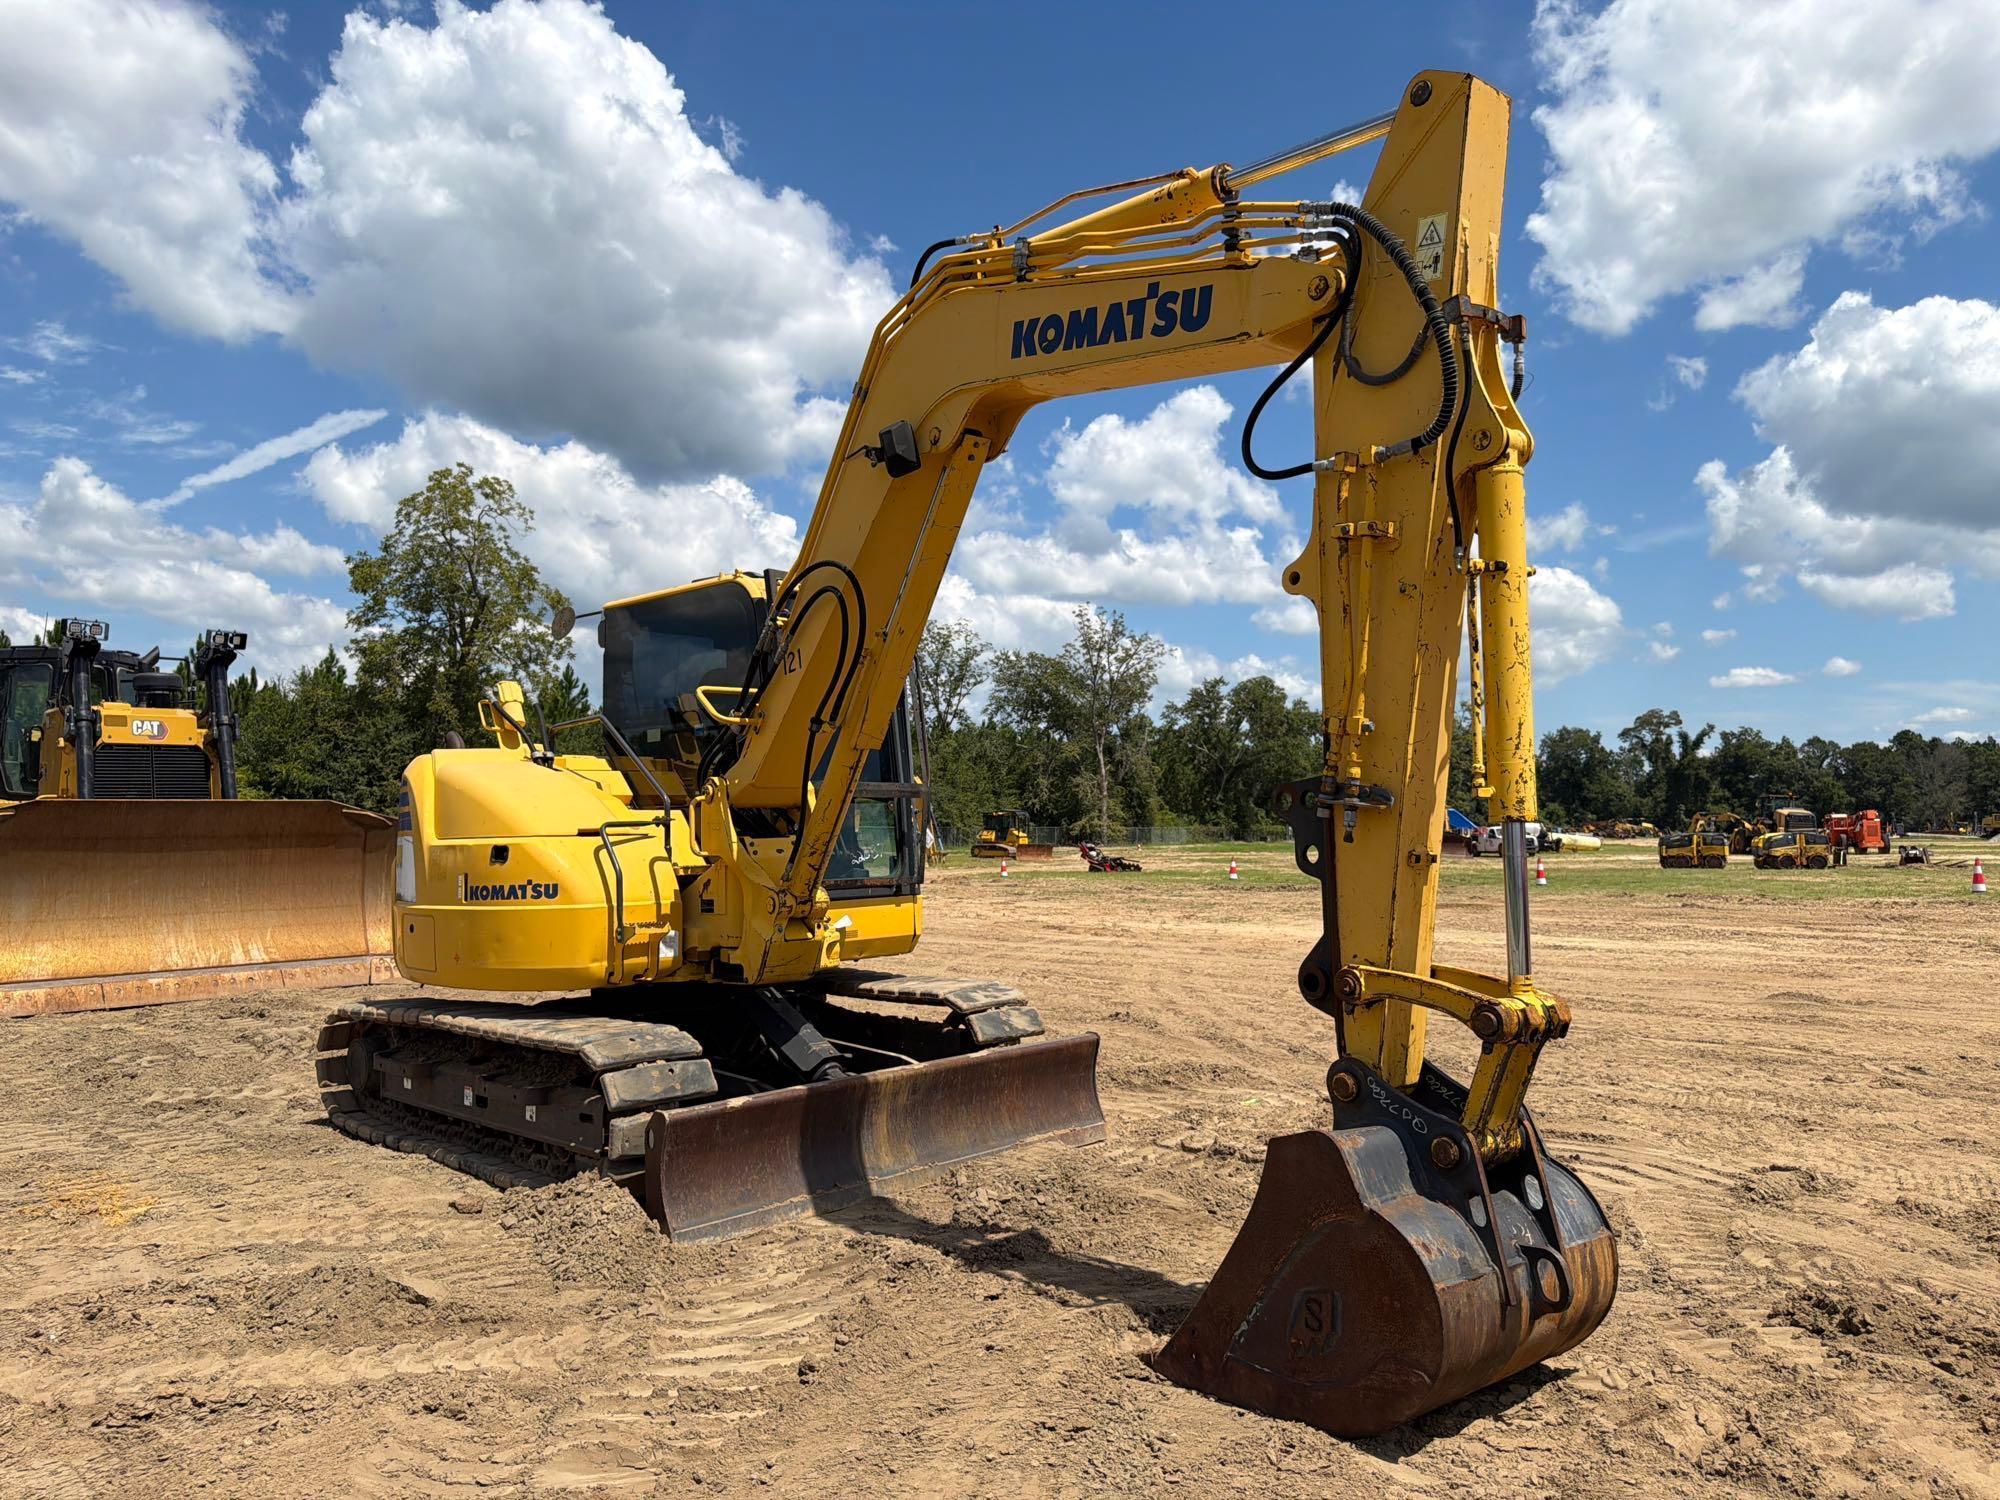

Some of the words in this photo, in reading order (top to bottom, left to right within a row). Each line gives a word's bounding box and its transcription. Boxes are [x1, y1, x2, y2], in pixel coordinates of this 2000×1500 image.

[1011, 281, 1214, 360] KOMATSU
[132, 720, 160, 736] CAT
[469, 879, 559, 901] KOMATSU
